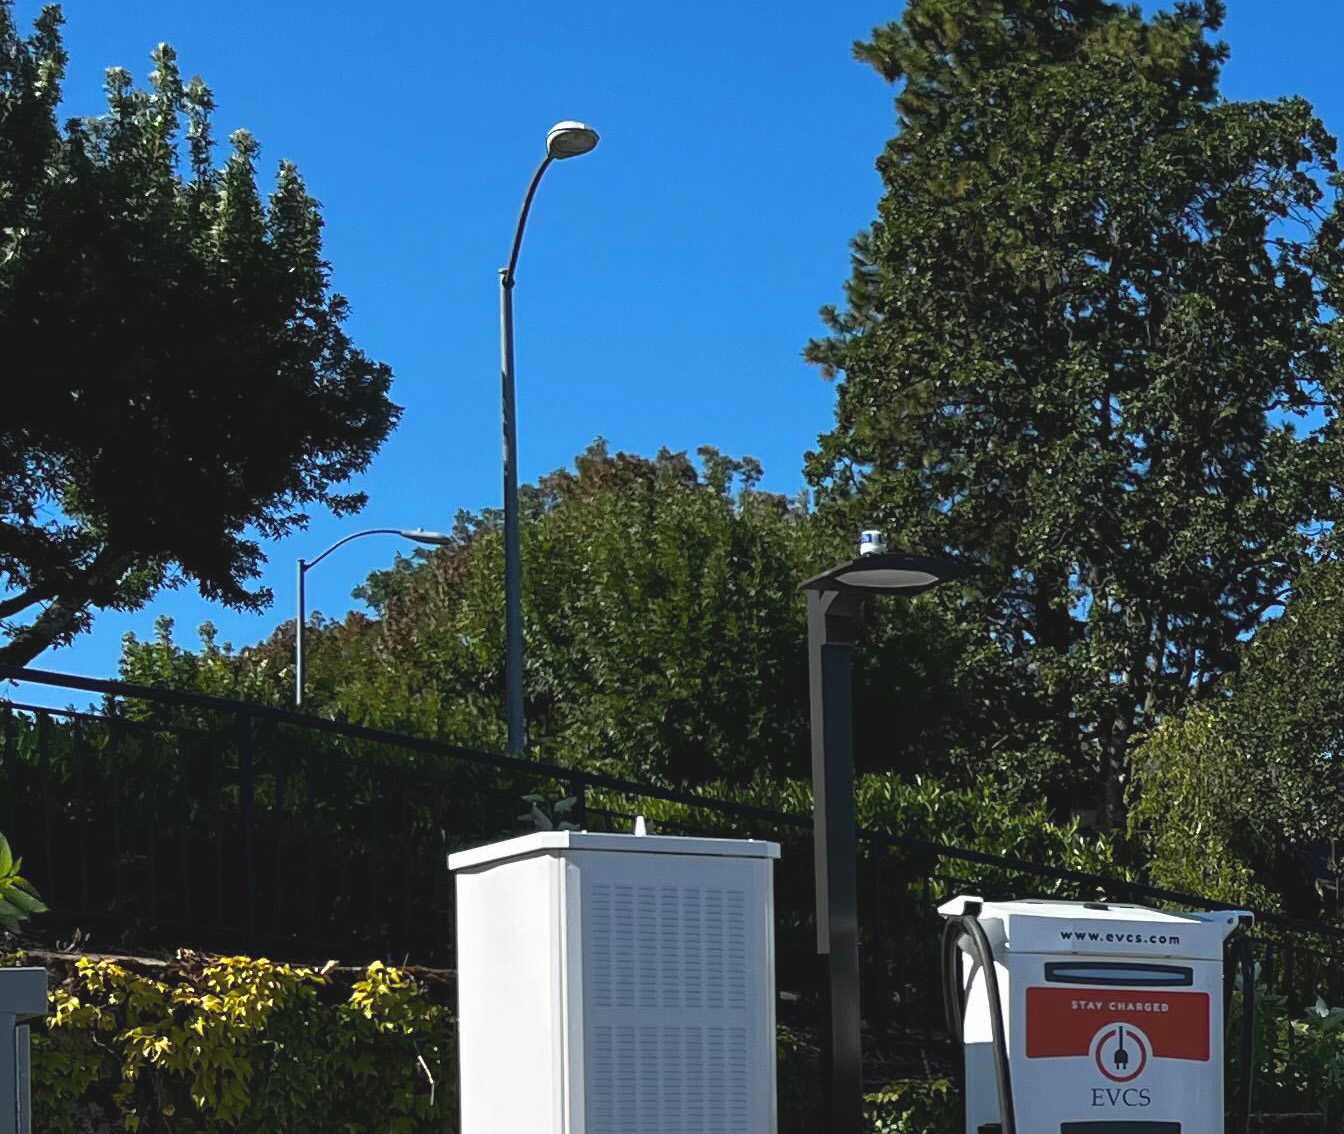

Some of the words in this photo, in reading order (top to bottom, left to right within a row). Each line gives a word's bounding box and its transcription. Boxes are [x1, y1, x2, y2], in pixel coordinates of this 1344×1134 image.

[1060, 931, 1180, 946] www.evcs.com
[1071, 1000, 1103, 1011] STAY
[1108, 1001, 1169, 1012] CHARGED
[1091, 1087, 1152, 1107] EVCS
